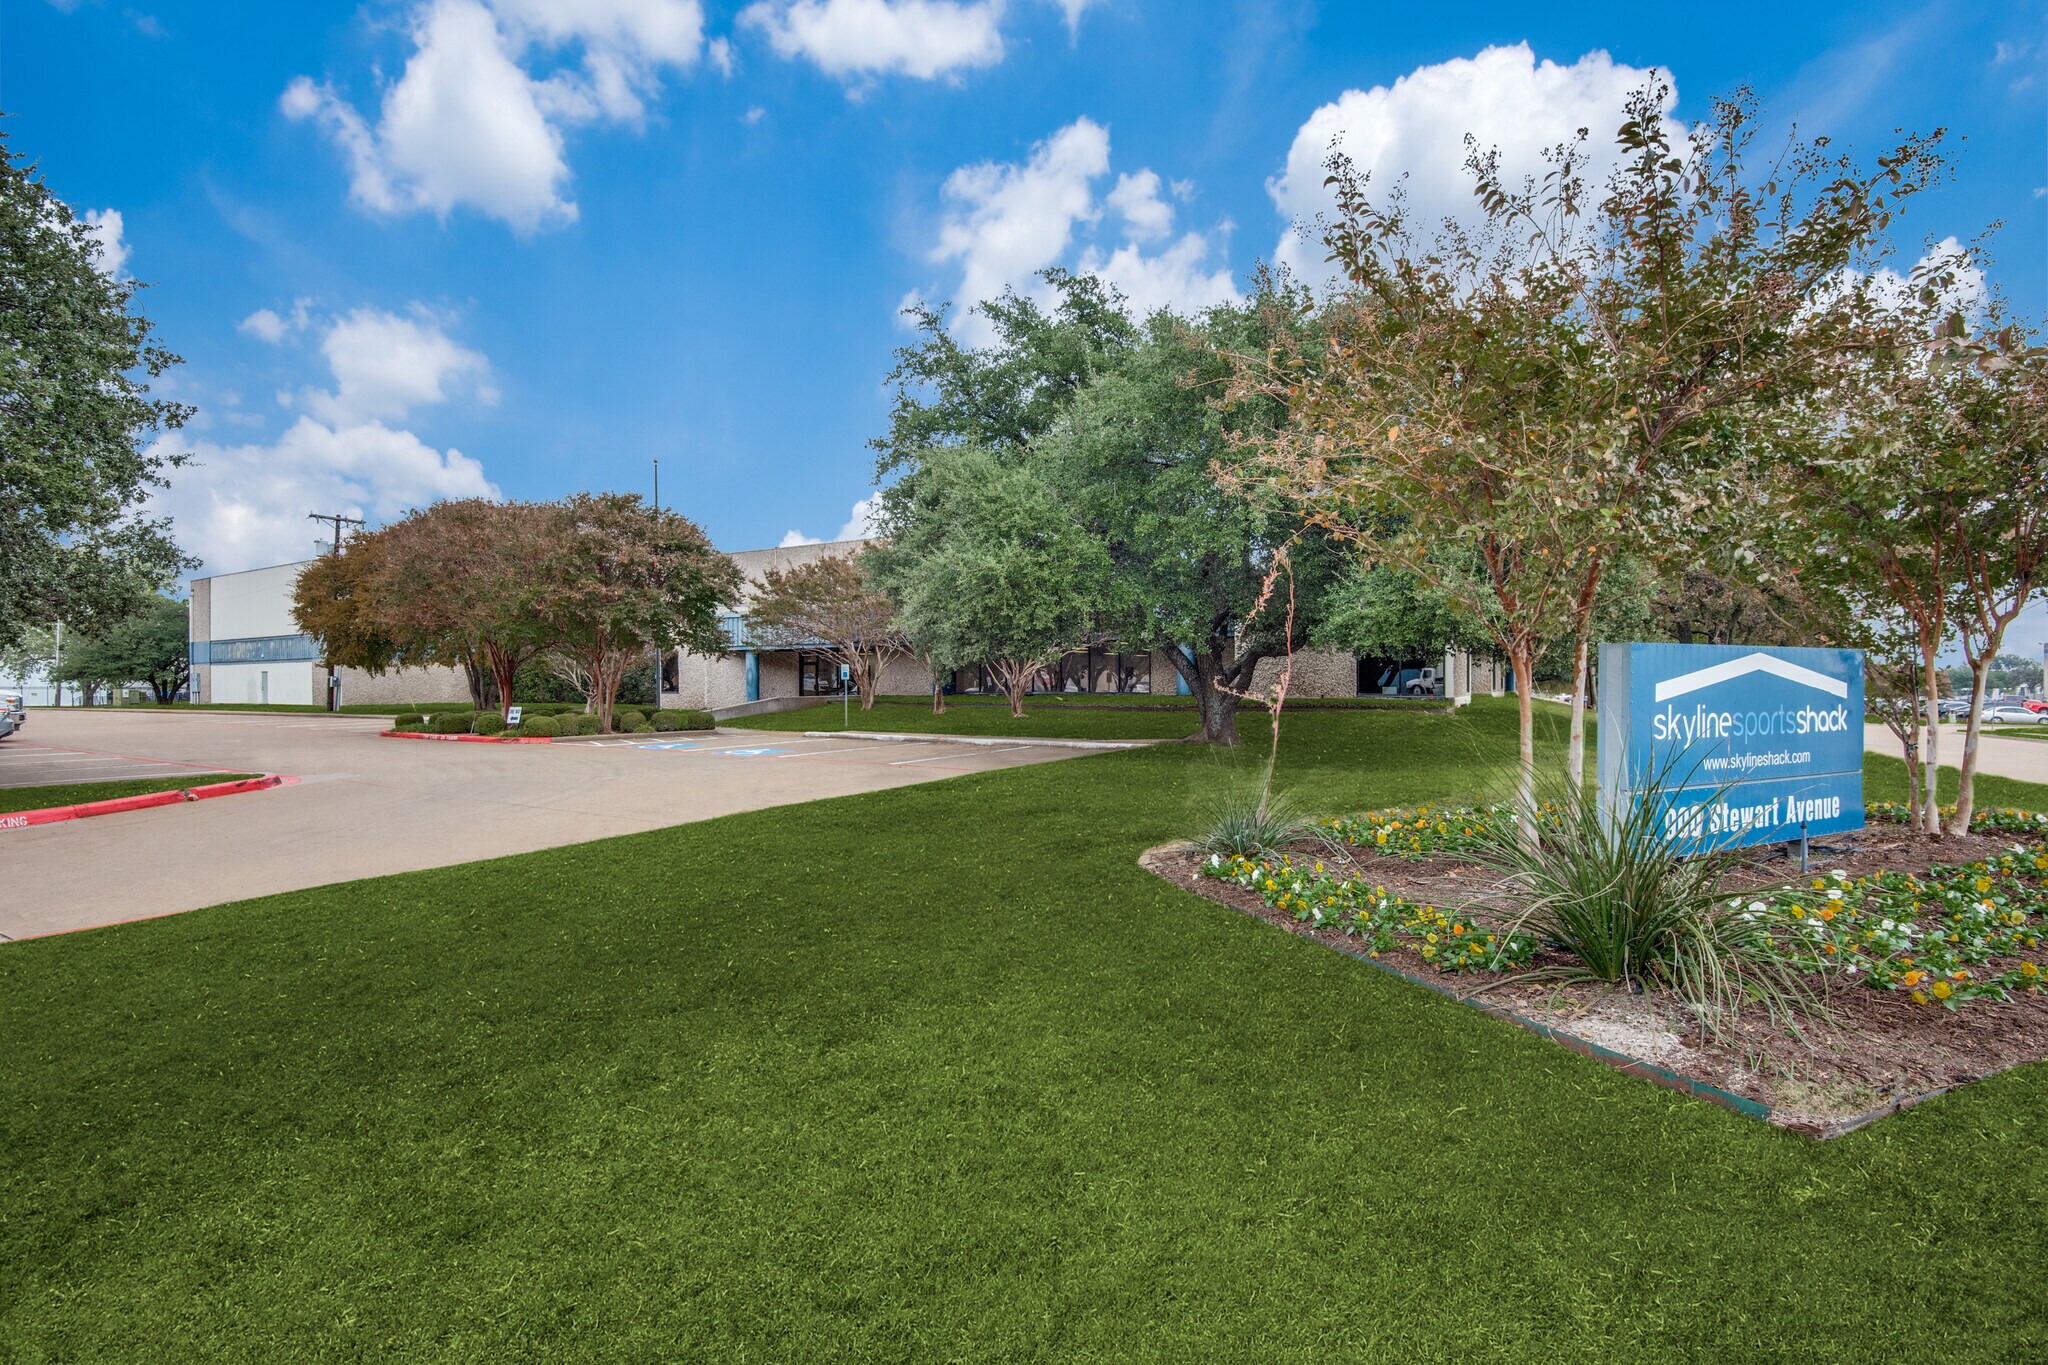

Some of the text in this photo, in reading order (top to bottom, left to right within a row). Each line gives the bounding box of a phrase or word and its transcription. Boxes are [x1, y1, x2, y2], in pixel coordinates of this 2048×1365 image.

[1703, 750, 1811, 771] www.skylineshack.com
[1665, 795, 1840, 840] 900 Stewart Avenue
